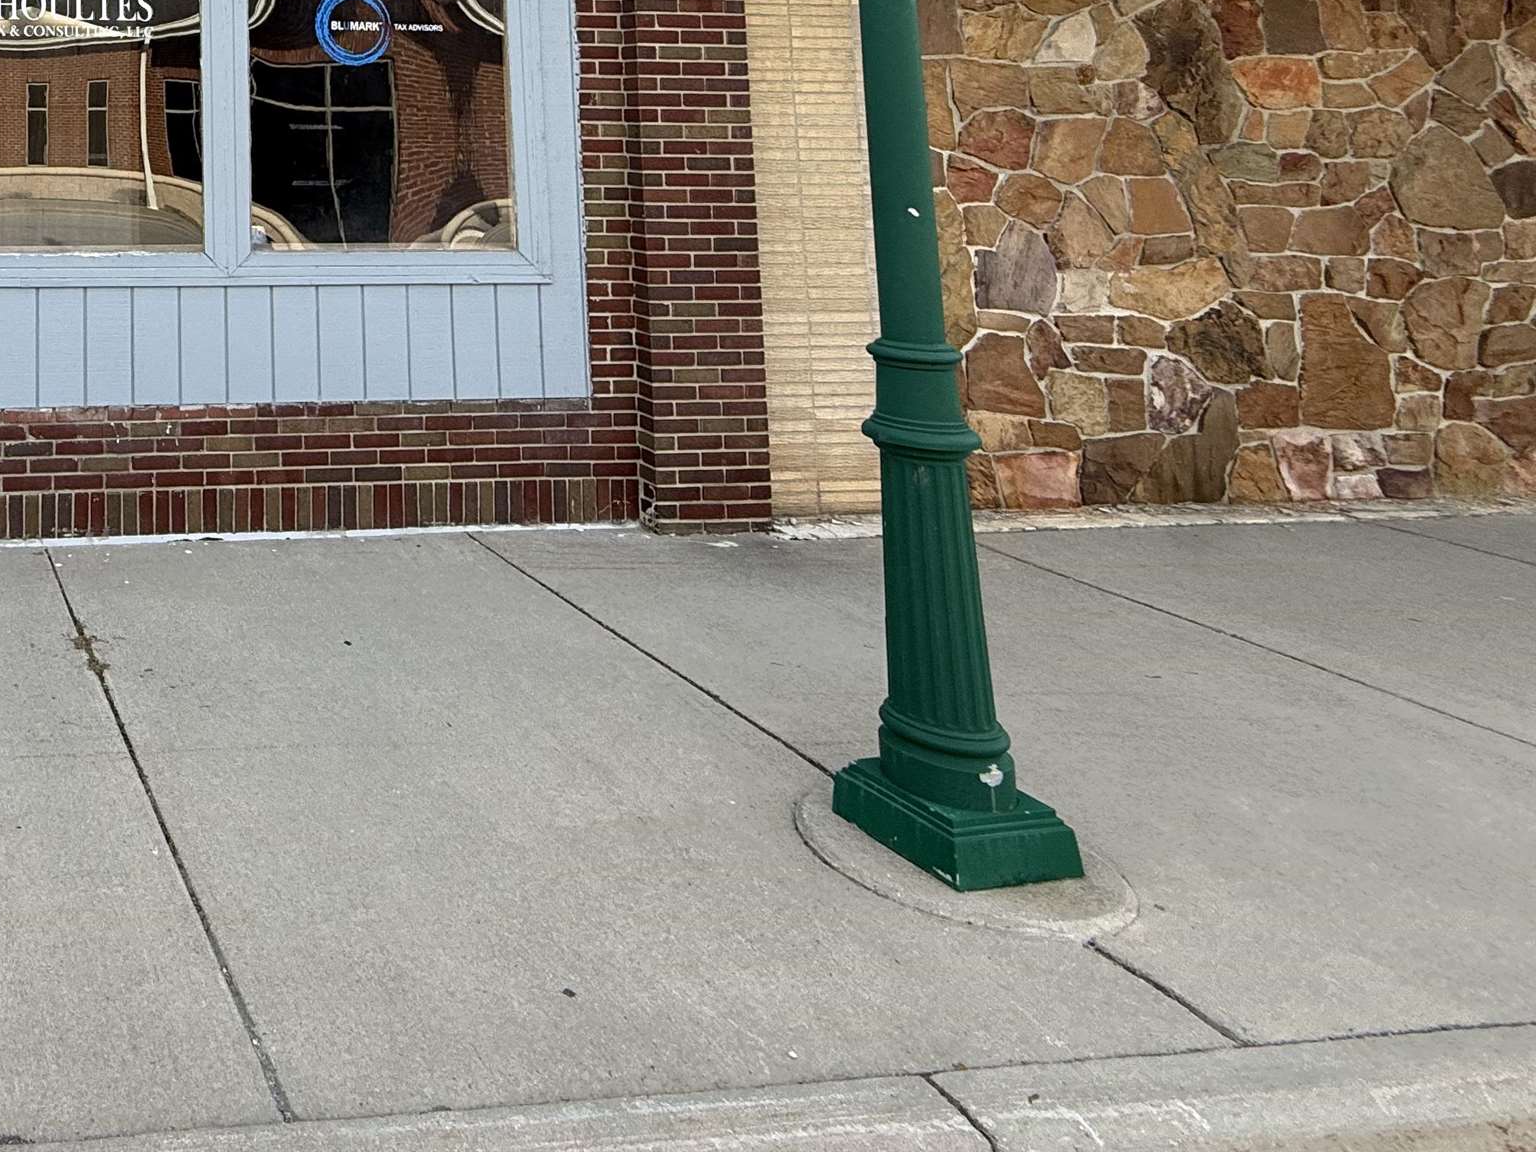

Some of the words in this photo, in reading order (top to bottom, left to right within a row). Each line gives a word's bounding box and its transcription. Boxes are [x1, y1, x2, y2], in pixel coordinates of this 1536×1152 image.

[9, 24, 21, 37] &
[393, 23, 408, 32] TAX
[408, 24, 444, 33] ADVISORS
